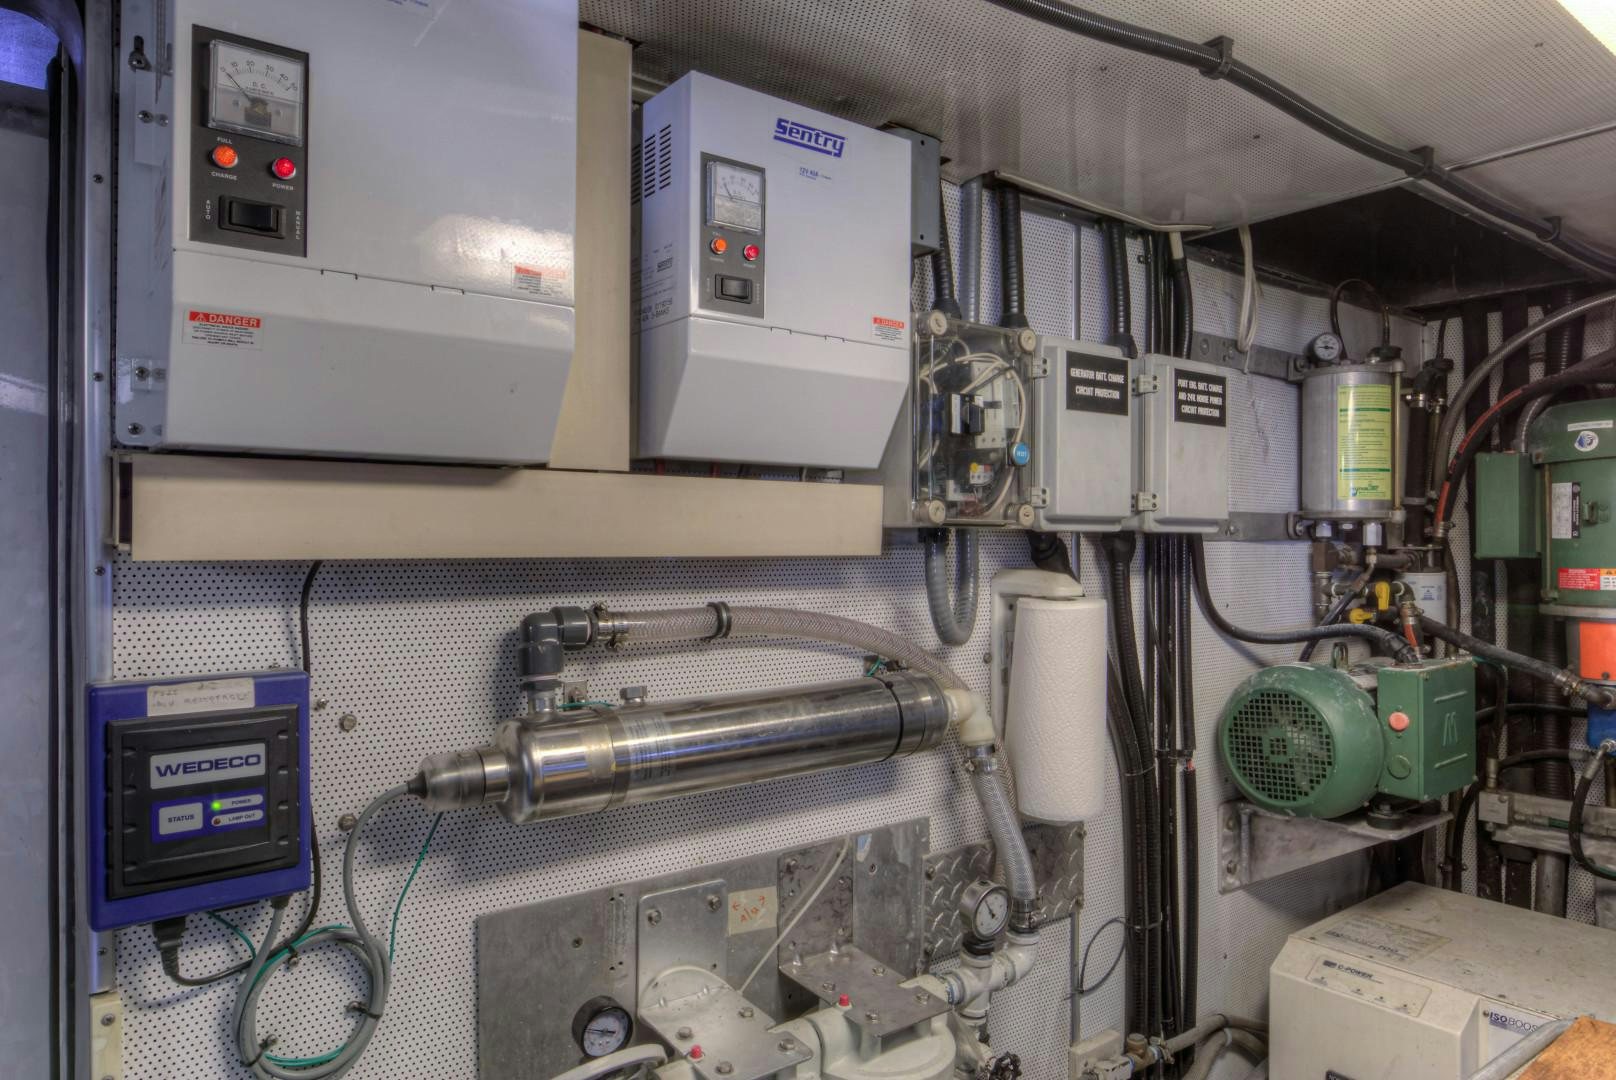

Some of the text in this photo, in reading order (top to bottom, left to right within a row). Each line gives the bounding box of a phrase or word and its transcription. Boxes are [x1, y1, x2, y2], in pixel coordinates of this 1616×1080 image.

[265, 64, 275, 72] 30
[279, 73, 289, 81] 40
[217, 136, 233, 145] FULL
[774, 117, 845, 158] Sentry
[211, 171, 238, 180] CHARGE
[272, 182, 294, 191] POWER
[208, 313, 257, 327] DANGER
[1071, 368, 1095, 380] GENERATOR
[1108, 373, 1124, 383] CHARGE
[1076, 386, 1119, 399] CIRCUIT PROTECTION
[156, 754, 261, 777] WEDECO
[168, 814, 194, 823] STATUS
